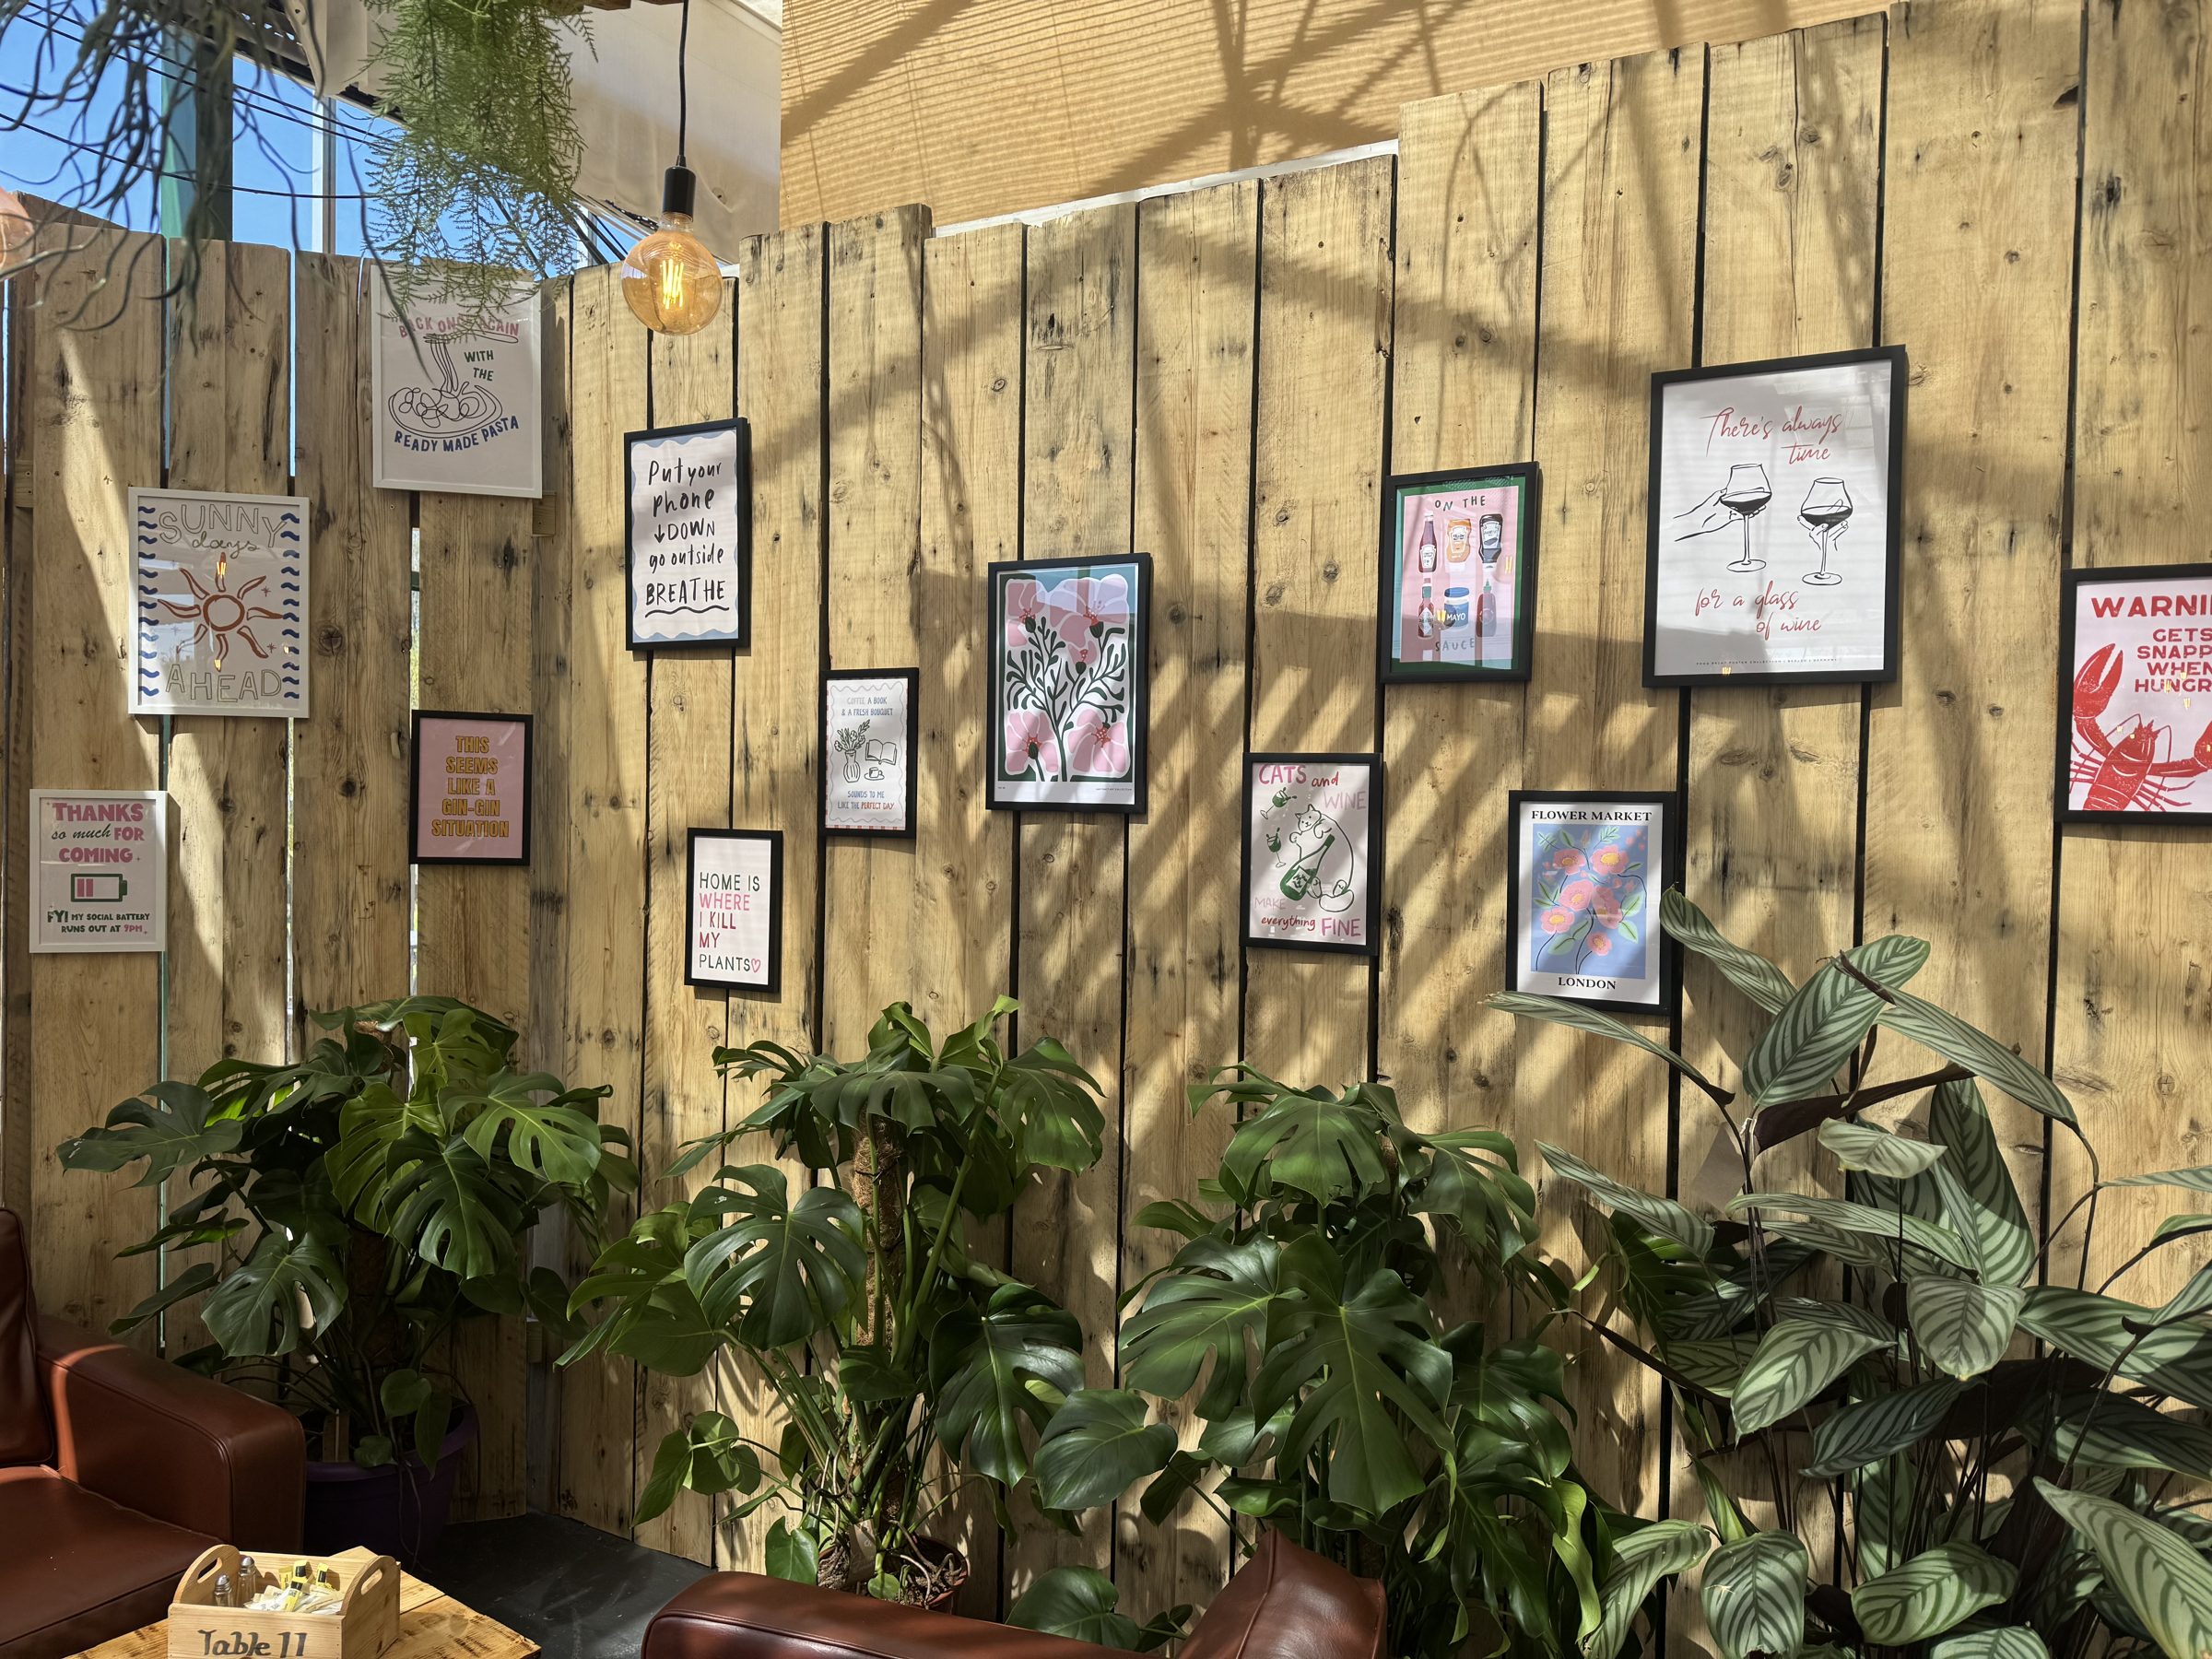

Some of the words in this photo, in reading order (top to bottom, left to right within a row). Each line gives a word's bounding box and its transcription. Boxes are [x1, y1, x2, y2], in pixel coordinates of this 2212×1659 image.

[464, 350, 494, 362] WITH
[473, 368, 494, 382] THE
[394, 430, 438, 452] READY
[443, 433, 479, 452] MADE
[482, 416, 519, 442] PASTA
[1700, 406, 1773, 457] There's
[1782, 406, 1843, 444] always
[1780, 441, 1831, 465] time
[649, 457, 683, 485] Put
[688, 462, 722, 486] your
[653, 488, 714, 517] phone
[1434, 500, 1453, 512] ON
[1463, 495, 1486, 507] THE
[159, 504, 288, 547] SUNNY
[668, 518, 715, 540] DOWN
[192, 532, 260, 559] days
[649, 553, 665, 573] go
[671, 543, 724, 566] outside
[646, 577, 725, 606] BREATHE
[1695, 586, 1724, 616] for
[1732, 594, 1745, 606] a
[1754, 581, 1799, 619] glass
[2090, 594, 2212, 618] WARNI
[1447, 612, 1465, 621] MAYO
[1756, 611, 1775, 641] of
[1781, 618, 1822, 632] wine
[2153, 628, 2212, 642] GETS
[1435, 638, 1475, 652] SAUCE
[2137, 645, 2212, 659] SNAPP
[2147, 662, 2212, 676] WHEN
[166, 664, 282, 702] AHEAD
[2135, 678, 2212, 693] HUNGR
[455, 735, 489, 754] THIS
[446, 756, 498, 774] SEEMS
[1259, 763, 1307, 784] CATS
[1311, 771, 1339, 787] and
[448, 778, 480, 794] LIKE
[485, 778, 496, 796] A
[442, 798, 500, 817] GIN-GIN
[837, 801, 849, 809] LIKE
[1324, 791, 1366, 811] WINE
[52, 802, 144, 822] THANKS
[1532, 810, 1587, 820] FLOWER
[1591, 811, 1653, 822] MARKET
[52, 831, 66, 840] so
[73, 823, 111, 839] much
[114, 826, 145, 841] FOR
[431, 819, 509, 837] SITUATION
[59, 846, 133, 863] COMING
[700, 872, 741, 891] HOME
[748, 876, 760, 892] IS
[699, 892, 750, 911] WHERE
[1253, 897, 1287, 911] MAKE
[124, 924, 142, 933] 9PM
[710, 912, 736, 929] KILL
[1261, 914, 1316, 931] everything
[1321, 918, 1361, 936] FINE
[699, 931, 721, 948] MY
[699, 953, 750, 971] PLANTS
[1558, 977, 1617, 990] LONDON
[197, 1628, 271, 1657] Table
[277, 1631, 308, 1659] 11
